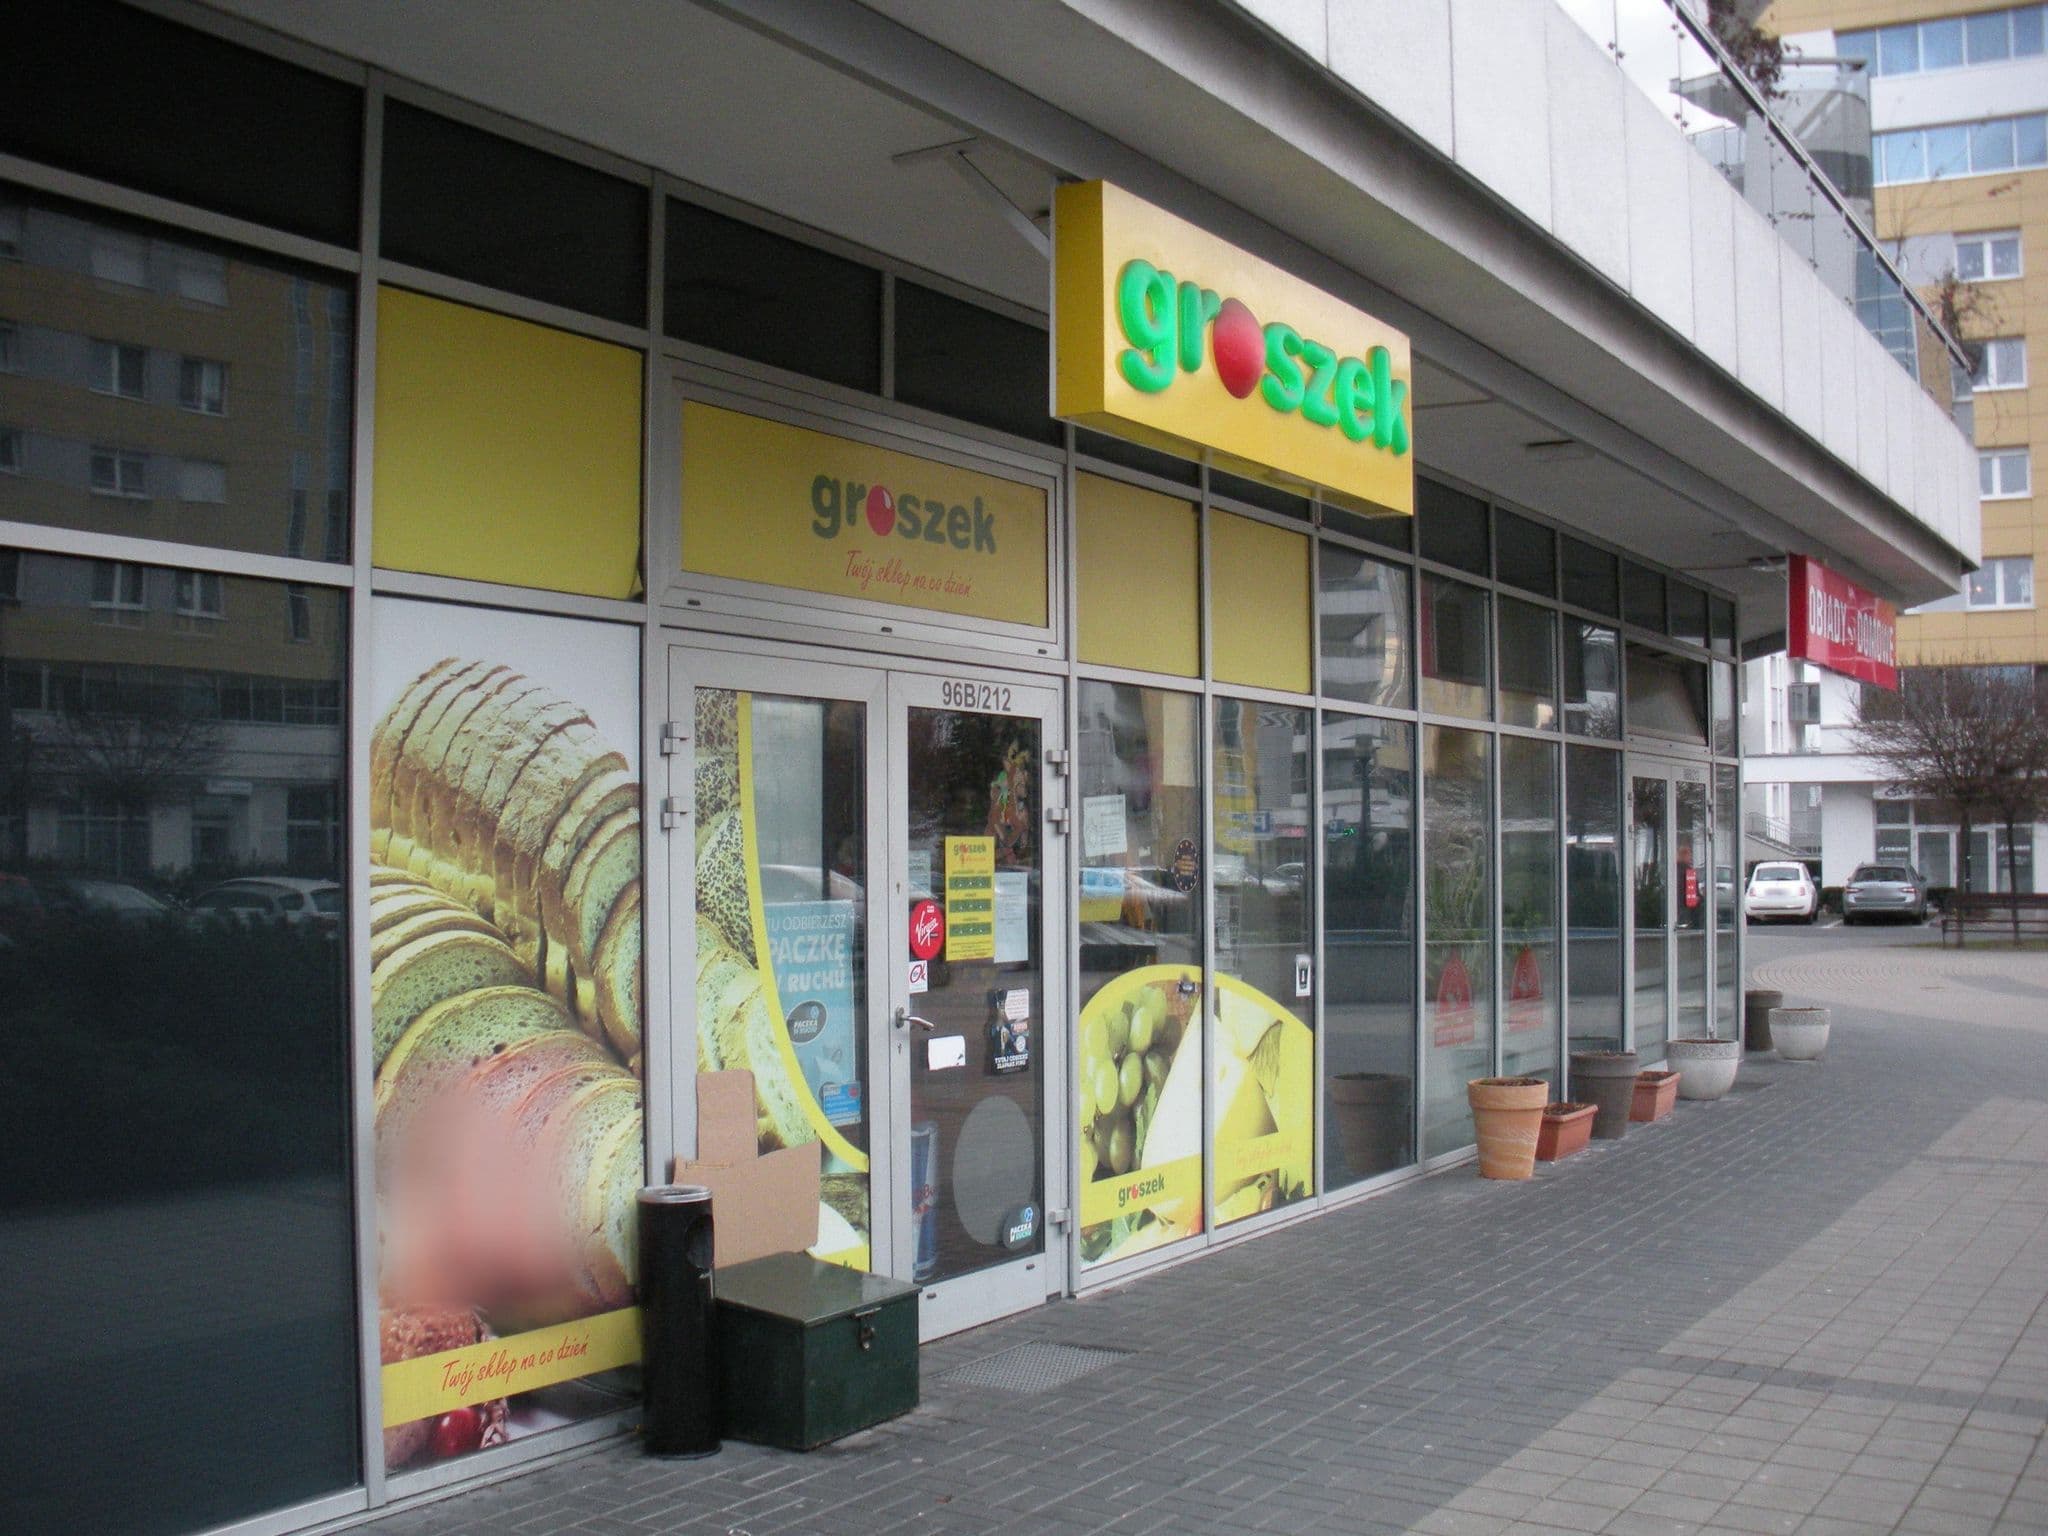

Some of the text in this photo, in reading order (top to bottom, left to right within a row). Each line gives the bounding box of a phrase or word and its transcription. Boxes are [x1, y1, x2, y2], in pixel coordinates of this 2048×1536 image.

[1117, 258, 1409, 456] groszek
[811, 474, 997, 555] groszek
[843, 549, 874, 592] Twój
[875, 559, 912, 593] sklep
[912, 573, 928, 591] na
[943, 570, 973, 598] dzień
[1808, 584, 1847, 647] OBIADY
[942, 680, 1011, 712] 96B/212
[782, 913, 847, 931] ODBIERZESZ
[915, 911, 939, 947] Virgin
[787, 969, 846, 993] RUCHU
[1118, 1172, 1165, 1209] groszek
[440, 1333, 591, 1397] Twój sklep na co dzień
